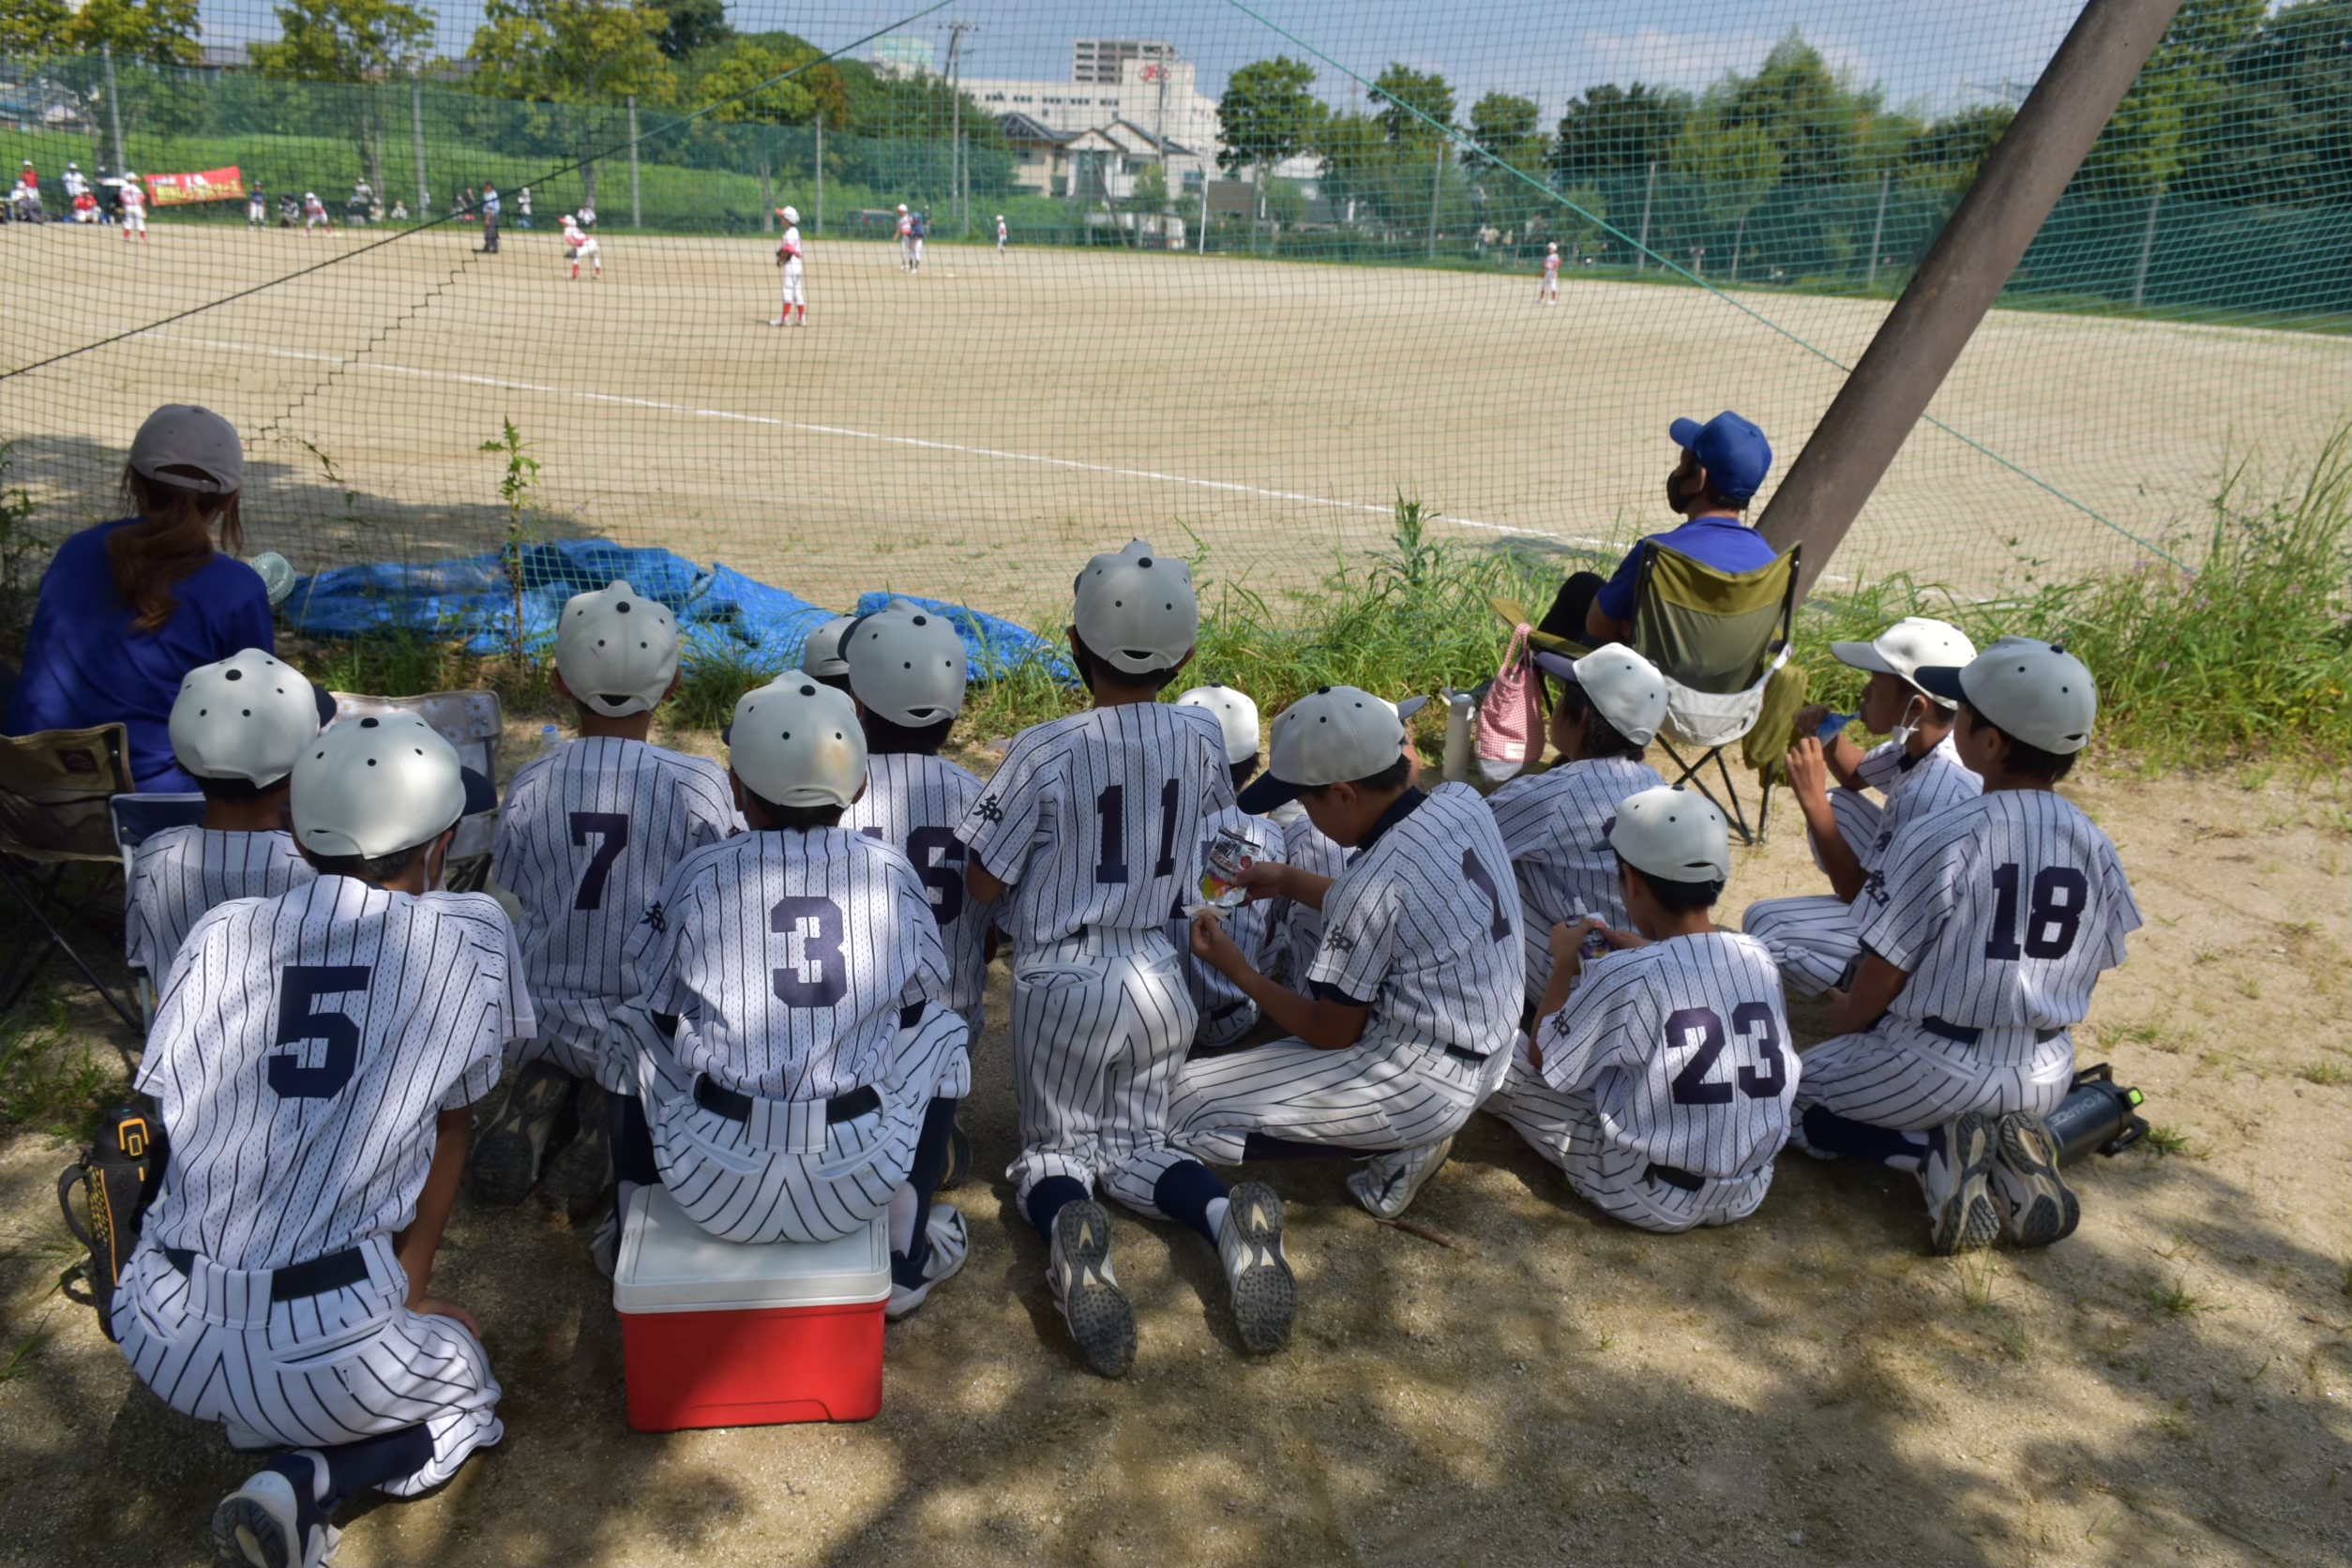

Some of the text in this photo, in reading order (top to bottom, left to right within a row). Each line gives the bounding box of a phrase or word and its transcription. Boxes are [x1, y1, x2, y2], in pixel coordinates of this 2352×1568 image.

[569, 812, 629, 910] 7
[862, 826, 965, 925] 6
[1095, 778, 1180, 883] 11
[1462, 847, 1511, 943] 1
[1985, 863, 2088, 961] 18
[770, 896, 848, 1008] 3
[267, 965, 371, 1102] 5
[1664, 1002, 1787, 1105] 23
